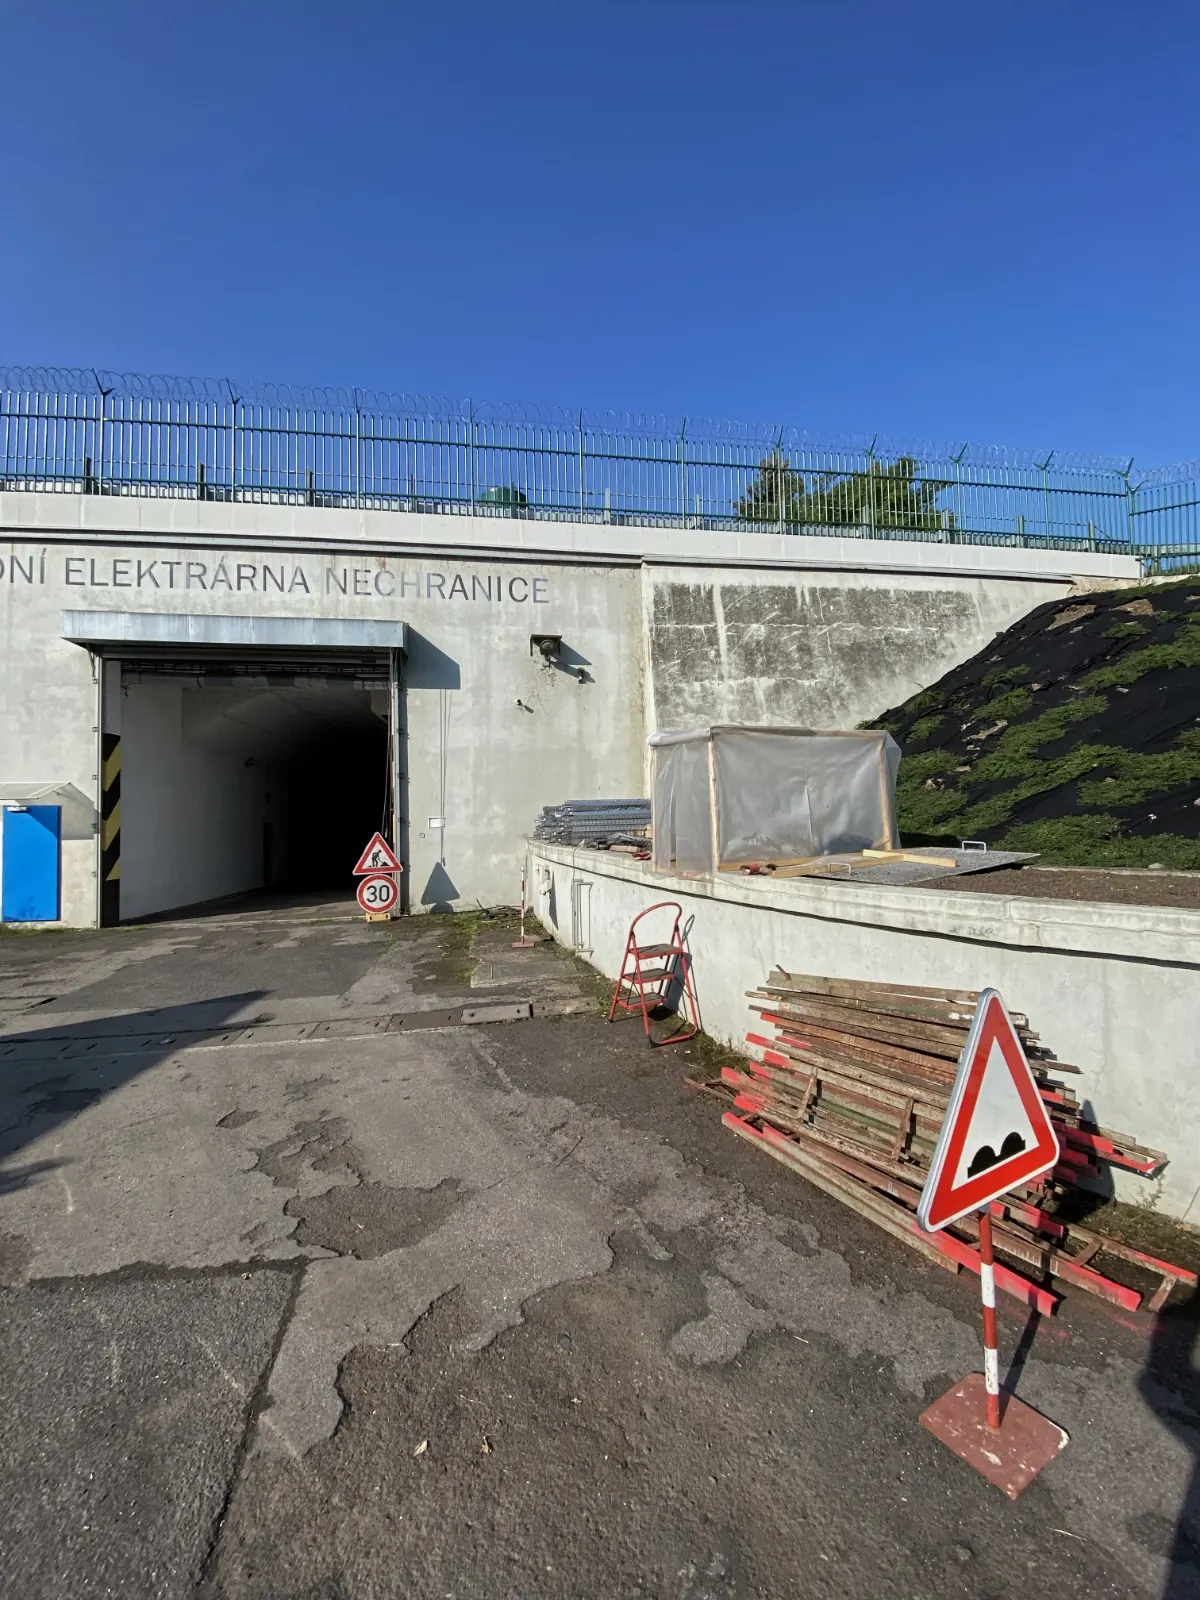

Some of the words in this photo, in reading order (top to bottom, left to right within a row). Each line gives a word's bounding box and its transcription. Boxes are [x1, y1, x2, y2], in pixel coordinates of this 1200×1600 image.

[0, 548, 47, 584] NÍ
[65, 556, 310, 594] ELEKTRÁRNA
[326, 567, 549, 603] NECHRANICE
[366, 885, 390, 902] 30
